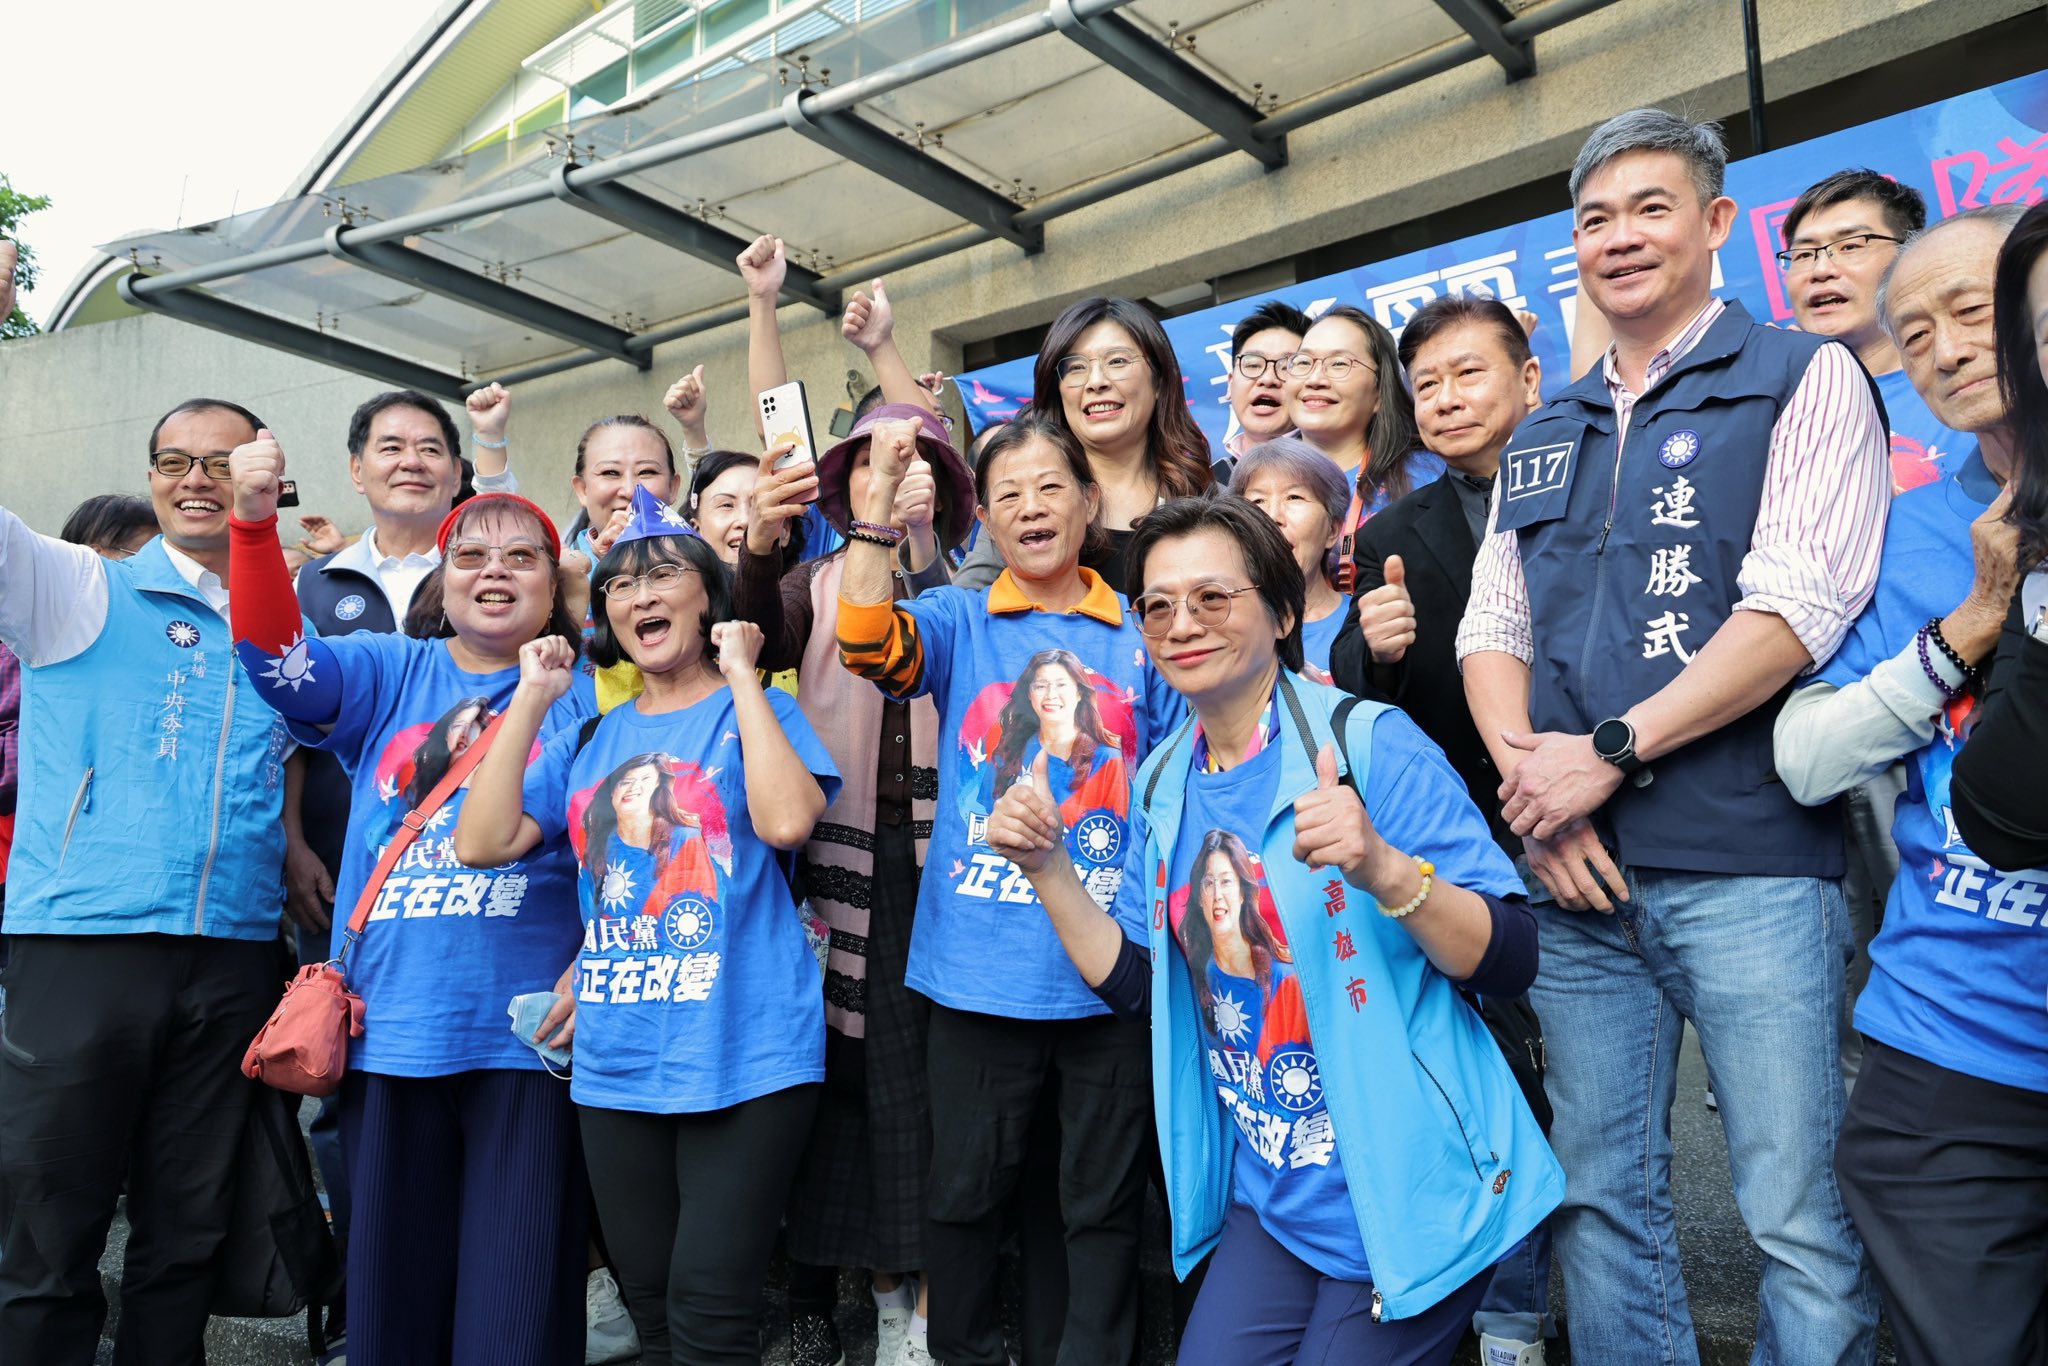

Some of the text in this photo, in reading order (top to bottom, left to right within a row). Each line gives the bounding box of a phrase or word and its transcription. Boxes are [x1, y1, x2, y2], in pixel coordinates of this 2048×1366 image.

[1510, 450, 1567, 492] 117
[1642, 475, 1703, 666] 連勝武
[156, 669, 188, 761] 中央委員
[368, 872, 529, 922] 正在改變
[955, 853, 1124, 913] 正在變
[1934, 853, 2048, 928] 正在
[578, 951, 721, 1004] 正在改變
[1322, 879, 1367, 1014] 高雄市
